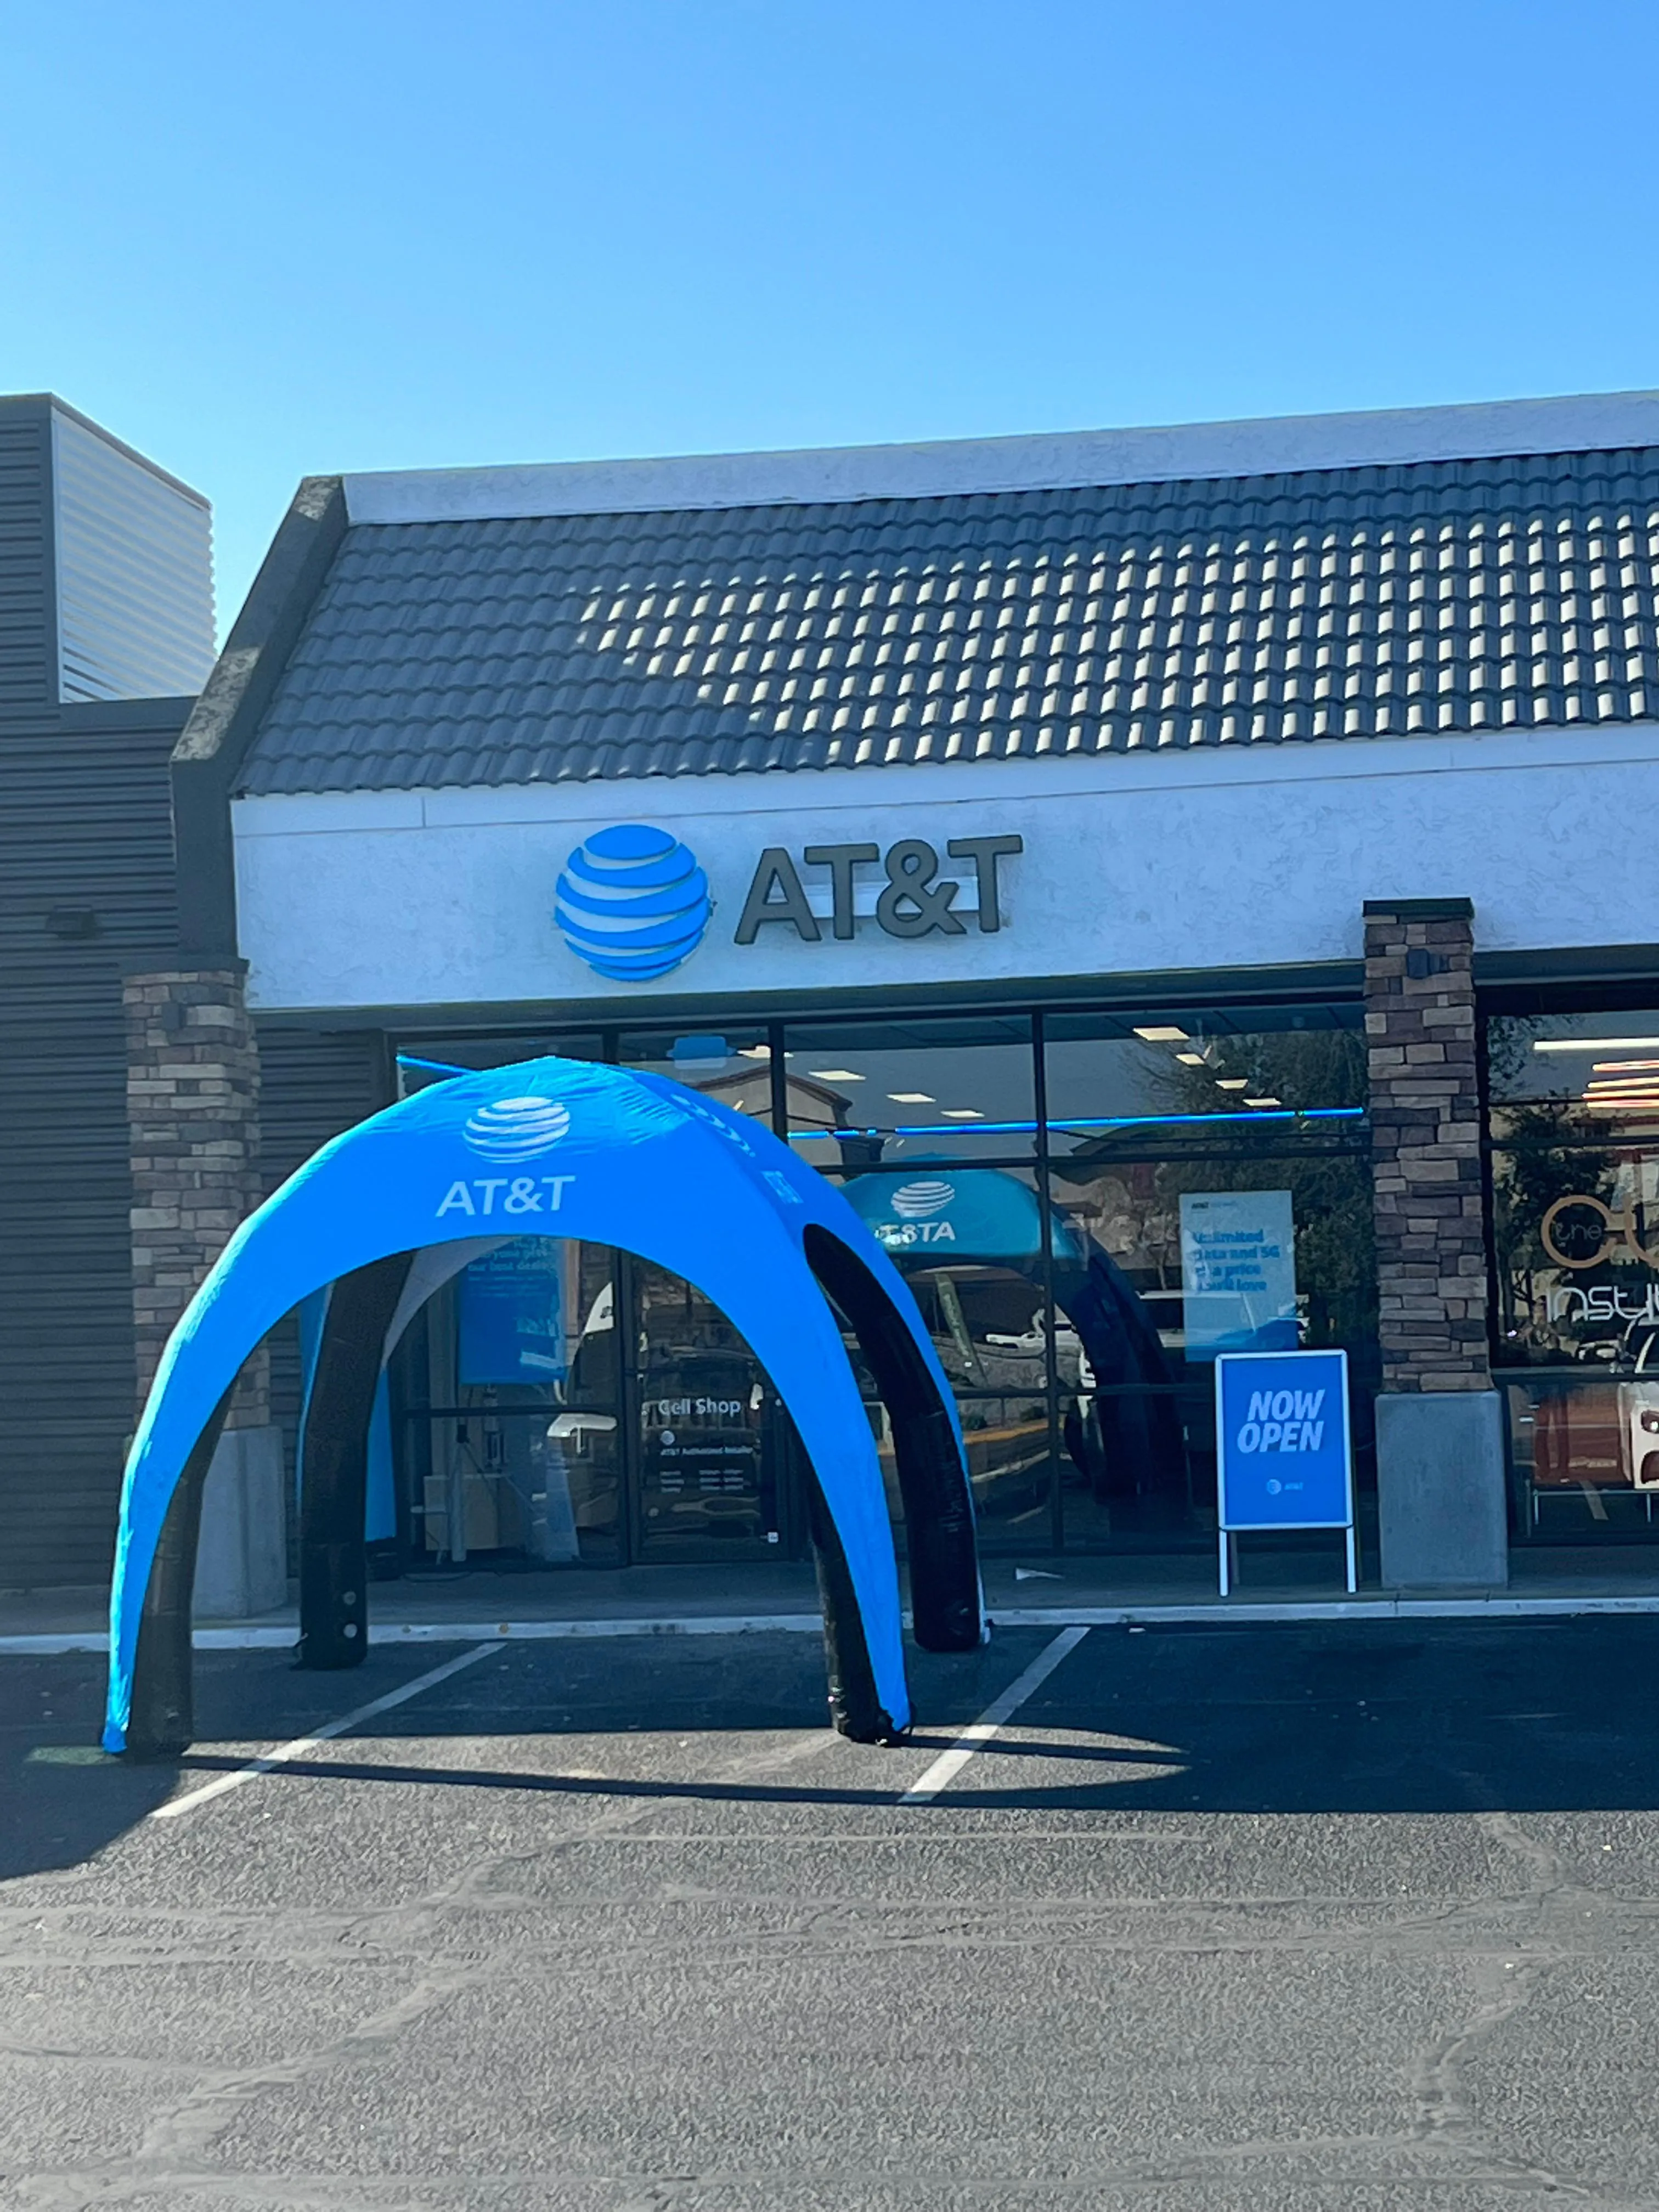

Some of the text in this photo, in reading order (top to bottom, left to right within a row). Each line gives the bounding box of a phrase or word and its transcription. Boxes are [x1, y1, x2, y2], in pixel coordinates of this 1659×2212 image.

[734, 835, 1023, 945] AT&T
[436, 1175, 575, 1217] AT&T
[658, 1397, 741, 1417] Cell Shop
[1248, 1389, 1325, 1421] NOW
[1237, 1421, 1324, 1453] OPEN
